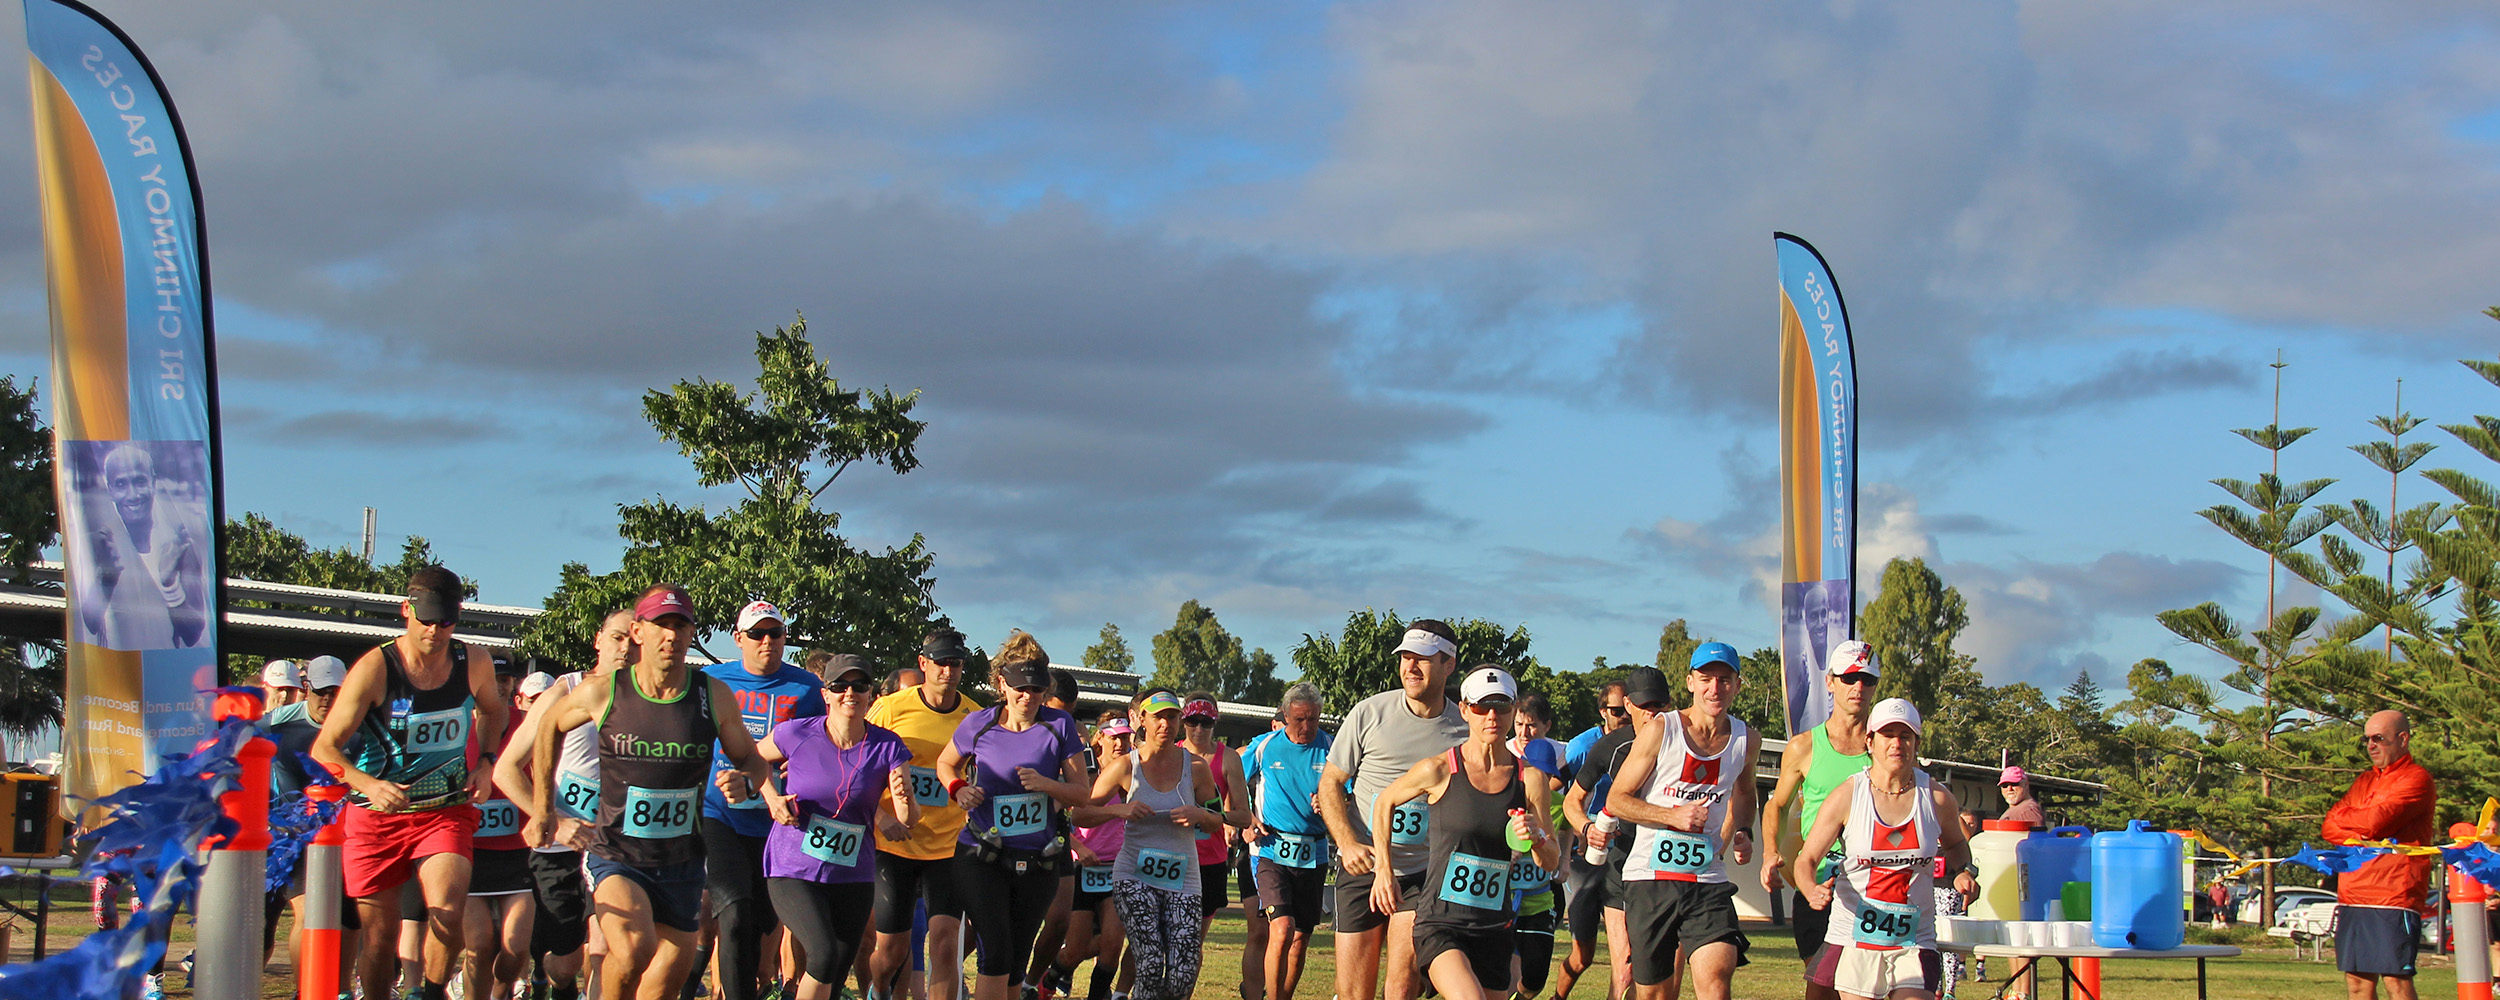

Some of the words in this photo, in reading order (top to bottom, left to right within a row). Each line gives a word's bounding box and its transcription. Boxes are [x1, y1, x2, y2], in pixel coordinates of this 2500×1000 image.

[735, 689, 769, 714] 013
[415, 718, 460, 745] 870
[610, 733, 709, 759] fitnance
[1663, 784, 1724, 803] intraining
[633, 800, 689, 828] 848
[1000, 801, 1042, 828] 842
[1391, 809, 1422, 836] 33
[810, 825, 857, 857] 840
[1279, 841, 1311, 862] 878
[1658, 839, 1706, 867] 835
[1141, 856, 1181, 880] 856
[1464, 857, 1490, 867] CHINMOY
[1491, 862, 1507, 870] RACES
[1510, 863, 1546, 882] 880
[1857, 854, 1932, 868] intraining
[1450, 865, 1502, 898] 886
[1860, 909, 1912, 937] 845
